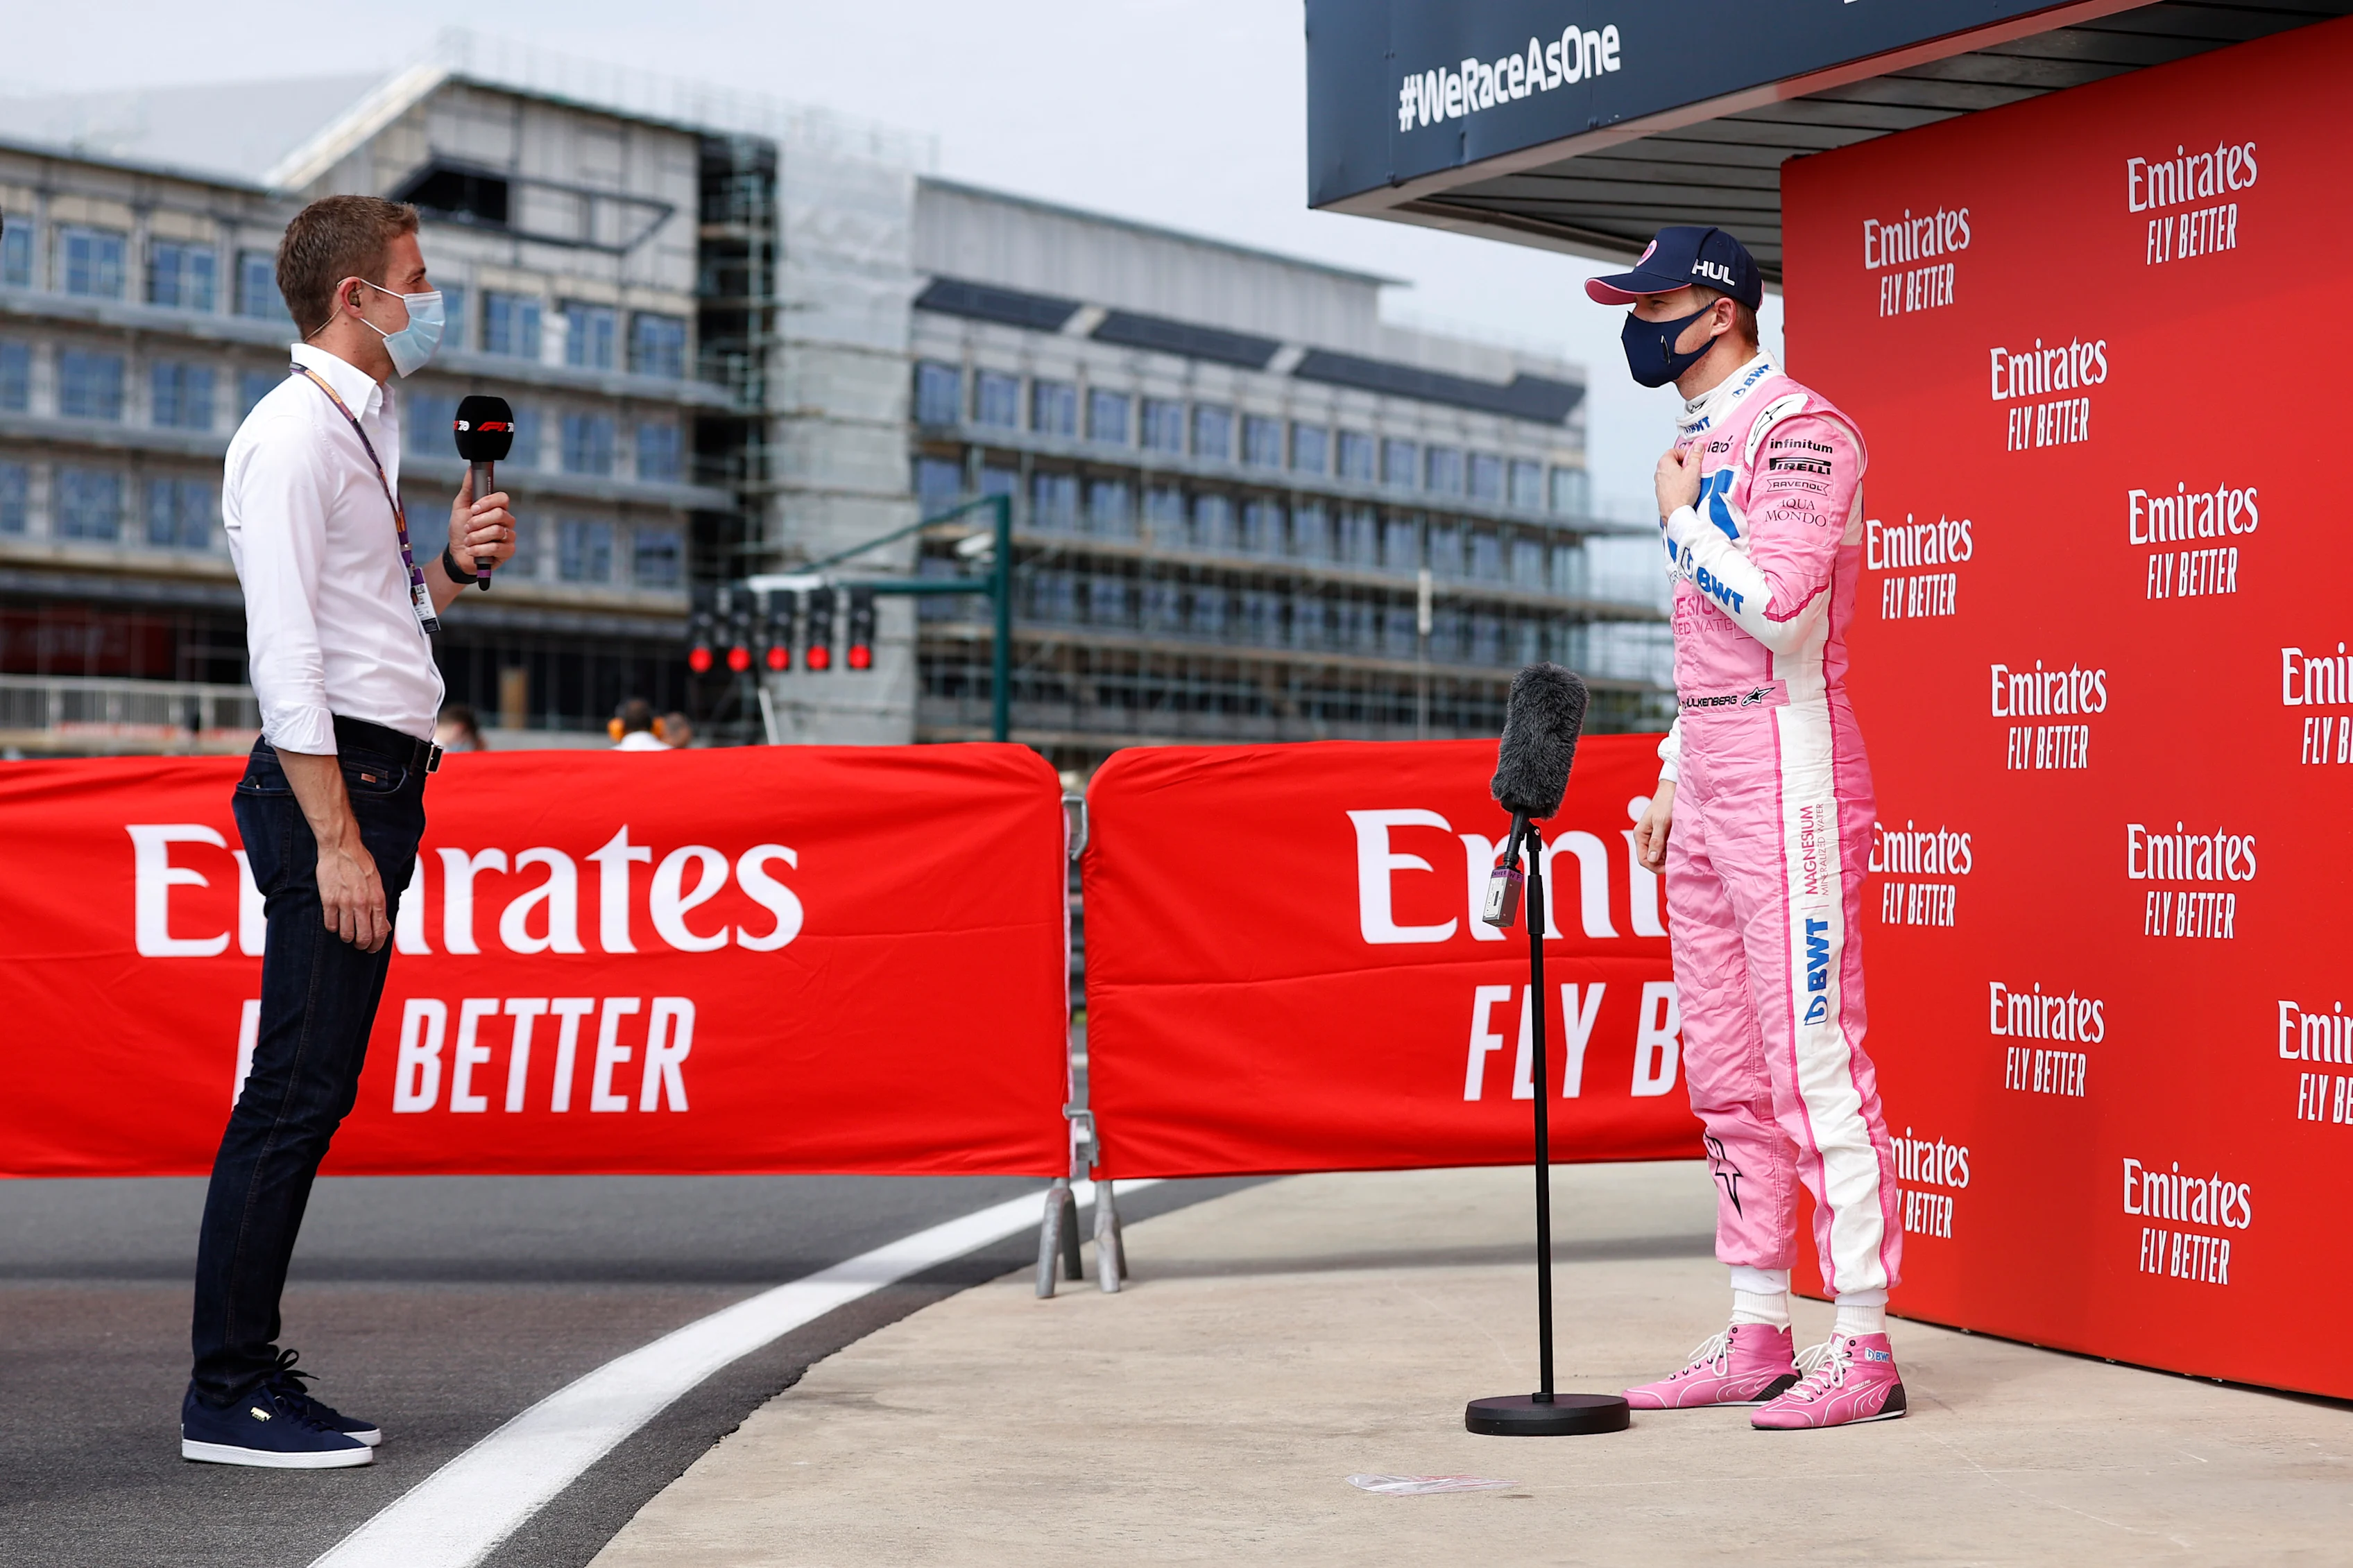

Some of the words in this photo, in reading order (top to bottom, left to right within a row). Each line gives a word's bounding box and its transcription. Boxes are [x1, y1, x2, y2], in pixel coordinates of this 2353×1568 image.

[1398, 24, 1621, 132] #WeRaceAsOne
[2127, 141, 2257, 213] Emirates
[1863, 207, 1970, 270] Emirates
[2146, 216, 2174, 266] FLY
[2177, 203, 2237, 259] BETTER
[1691, 258, 1735, 286] HUL
[1879, 273, 1903, 318] FLY
[1906, 263, 1954, 313] BETTER
[1990, 336, 2107, 401] Emirates
[1706, 437, 1732, 453] laro
[1770, 438, 1833, 454] infinitum
[2008, 406, 2033, 451] FLY
[2035, 397, 2089, 448] BETTER
[1769, 457, 1832, 475] PIRELLI
[1772, 481, 1823, 491] RAVENOL
[1765, 510, 1827, 527] MONDO
[1777, 498, 1815, 510] AQUA
[2128, 481, 2259, 545] Emirates
[1865, 513, 1973, 571] Emirates
[1697, 566, 1745, 616] BWT
[1881, 577, 1905, 620] FLY
[1907, 573, 1956, 618] BETTER
[2146, 553, 2175, 600] FLY
[2177, 547, 2238, 597] BETTER
[1693, 618, 1736, 634] WATE
[1990, 660, 2107, 717] Emirates
[2007, 727, 2033, 770] FLY
[2035, 725, 2089, 770] BETTER
[2302, 717, 2334, 765] FLY
[1816, 803, 1824, 834] WATER
[1799, 805, 1818, 895] MAGNESIUM
[1817, 836, 1829, 896] MINERALIZED
[1867, 819, 1972, 875] Emirates
[2126, 821, 2257, 881] Emirates
[126, 824, 804, 957] Erates
[1881, 882, 1905, 924] FLY
[1907, 884, 1956, 927] BETTER
[2144, 891, 2173, 937] FLY
[2175, 892, 2236, 939] BETTER
[1805, 918, 1830, 992] BWT
[1989, 981, 2105, 1044] Emirates
[393, 997, 696, 1113] BETTER
[1464, 983, 1607, 1101] FLY
[2005, 1047, 2030, 1091] FLY
[2033, 1049, 2087, 1097] BETTER
[2298, 1073, 2329, 1121] FLY
[1889, 1126, 1969, 1189] mirates
[1905, 1189, 1953, 1239] BETTER
[2123, 1157, 2251, 1230] Emirates
[2139, 1227, 2168, 1275] FLY
[2170, 1232, 2230, 1285] BETTER
